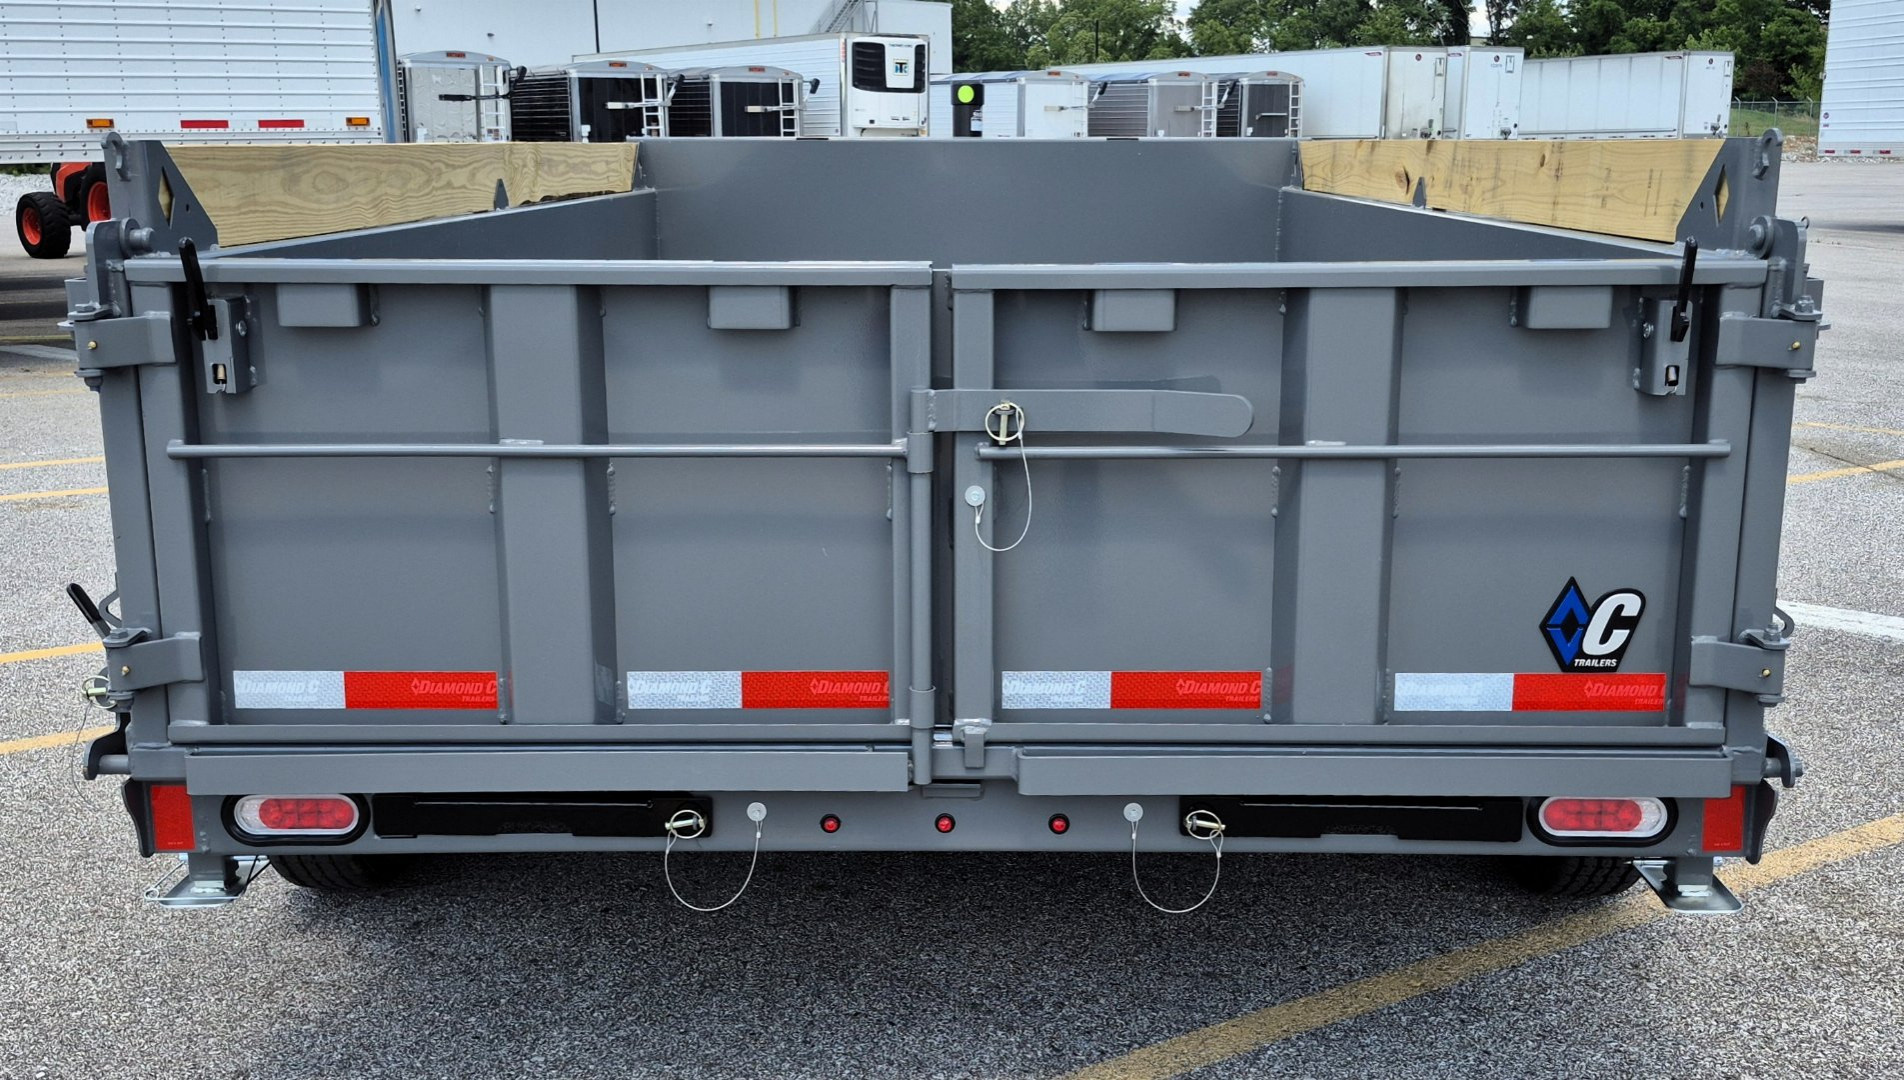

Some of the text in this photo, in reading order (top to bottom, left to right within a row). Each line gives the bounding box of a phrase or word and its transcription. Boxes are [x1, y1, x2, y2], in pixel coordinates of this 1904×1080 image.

[1582, 592, 1642, 656] C
[1574, 658, 1618, 667] TRAILERS
[418, 680, 497, 694] DIAMOND C
[817, 680, 881, 694] DIAMOND
[1183, 680, 1261, 694] DIAMOND C
[1591, 682, 1658, 697] DIAMOND
